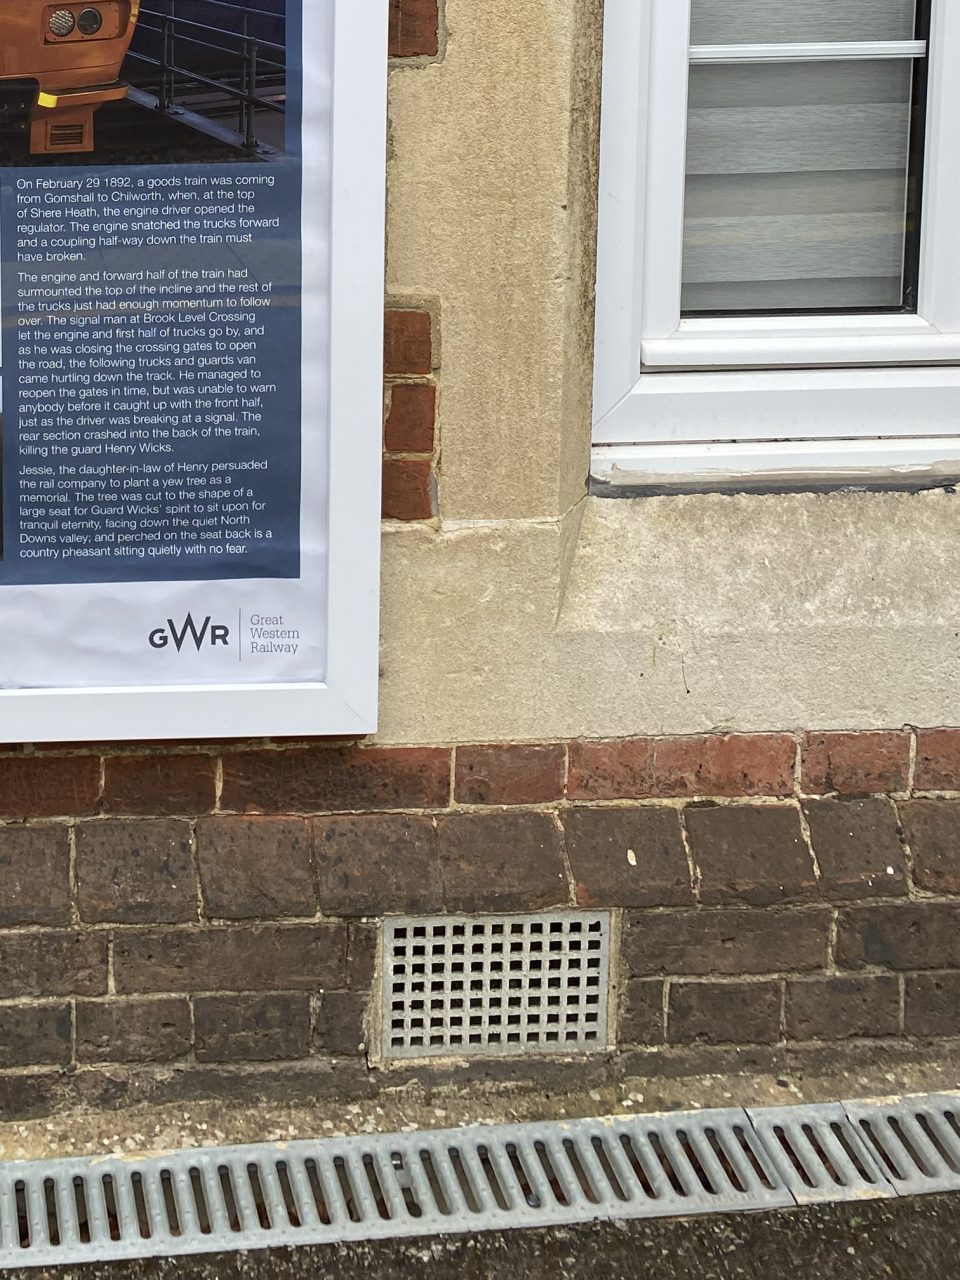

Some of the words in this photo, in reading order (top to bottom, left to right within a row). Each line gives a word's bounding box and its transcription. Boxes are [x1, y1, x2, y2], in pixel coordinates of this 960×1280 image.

[16, 179, 32, 189] On
[36, 178, 83, 191] February
[86, 178, 99, 187] 29
[104, 177, 133, 189] 1892,
[147, 176, 181, 189] goods
[184, 176, 207, 186] train
[210, 177, 232, 186] was
[235, 174, 274, 188] coming
[16, 193, 41, 203] from
[44, 192, 94, 203] Gomshall
[97, 193, 108, 201] to
[111, 191, 164, 201] Chilworth,
[167, 190, 199, 202] when,
[203, 190, 213, 199] at
[216, 189, 234, 199] the
[237, 189, 255, 201] top
[16, 208, 27, 218] of
[30, 207, 61, 218] Shere
[65, 207, 99, 218] Heath,
[102, 206, 120, 216] the
[123, 206, 158, 217] engine
[161, 205, 191, 214] driver
[193, 203, 234, 216] opened
[237, 203, 254, 213] the
[17, 222, 65, 235] regulator.
[69, 221, 89, 231] The
[92, 220, 128, 233] engine
[131, 219, 180, 230] snatched
[183, 219, 200, 229] the
[203, 218, 236, 228] trucks
[239, 217, 279, 227] forward
[16, 237, 37, 247] and
[50, 236, 95, 248] coupling
[98, 235, 143, 247] half-way
[146, 234, 176, 244] down
[179, 234, 196, 243] the
[199, 233, 222, 243] train
[225, 233, 252, 242] must
[17, 251, 42, 261] have
[46, 251, 85, 261] broken.
[17, 301, 34, 311] the
[38, 301, 70, 311] trucks
[73, 300, 92, 312] just
[95, 300, 115, 309] had
[119, 299, 158, 311] enough
[162, 298, 223, 308] momentum
[226, 297, 237, 307] to
[240, 296, 270, 306] follow
[17, 317, 42, 325] over.
[46, 315, 66, 325] The
[69, 314, 99, 327] signal
[103, 316, 126, 324] man
[129, 314, 139, 323] at
[143, 313, 175, 323] Brook
[178, 312, 205, 323] Level
[208, 311, 255, 324] Crossing
[18, 346, 31, 354] as
[33, 344, 47, 354] he
[50, 345, 72, 354] was
[75, 343, 112, 355] closing
[115, 343, 132, 352] the
[135, 342, 179, 354] crossing
[182, 341, 212, 353] gates
[215, 341, 226, 350] to
[229, 342, 256, 351] open
[18, 375, 48, 383] came
[51, 372, 90, 385] hurtling
[93, 372, 122, 381] down
[125, 371, 143, 381] the
[145, 371, 175, 380] track.
[179, 370, 194, 379] He
[197, 369, 247, 382] managed
[250, 369, 261, 378] to
[18, 401, 64, 414] anybody
[67, 401, 101, 411] before
[104, 401, 110, 410] it
[113, 400, 149, 412] caught
[153, 401, 167, 411] up
[169, 399, 191, 408] with
[194, 398, 211, 408] the
[214, 397, 238, 408] front
[241, 396, 263, 409] half,
[19, 433, 40, 441] rear
[42, 430, 80, 440] section
[83, 429, 126, 439] crashed
[129, 429, 149, 438] into
[152, 428, 169, 438] the
[172, 427, 198, 437] back
[200, 427, 212, 436] of
[214, 427, 231, 436] the
[234, 426, 260, 436] train,
[19, 445, 48, 457] killing
[51, 445, 68, 454] the
[70, 444, 101, 456] guard
[105, 443, 136, 455] Henry
[138, 442, 174, 452] Wicks.
[18, 464, 55, 476] Jessie,
[58, 465, 76, 474] the
[78, 463, 161, 476] daughter-in-law
[163, 462, 174, 472] of
[177, 462, 208, 473] Henry
[211, 460, 267, 472] persuaded
[19, 506, 45, 518] large
[48, 505, 70, 516] seat
[73, 505, 88, 515] for
[90, 504, 123, 514] Guard
[165, 502, 190, 515] spirit
[193, 502, 204, 512] to
[206, 502, 218, 512] sit
[221, 503, 248, 514] upon
[251, 500, 266, 510] for
[19, 519, 58, 532] tranquil
[61, 518, 101, 530] eternity,
[105, 517, 136, 530] facing
[139, 516, 169, 527] down
[172, 516, 189, 526] the
[191, 515, 217, 527] quiet
[220, 514, 250, 524] North
[19, 547, 59, 559] country
[62, 546, 110, 558] pheasant
[113, 545, 144, 557] sitting
[147, 544, 181, 557] quietly
[184, 544, 206, 553] with
[209, 545, 223, 553] no
[225, 542, 247, 553] fear.
[250, 614, 283, 626] Great
[149, 611, 229, 653] GWR
[250, 627, 299, 639] Western
[251, 641, 298, 655] Railway
